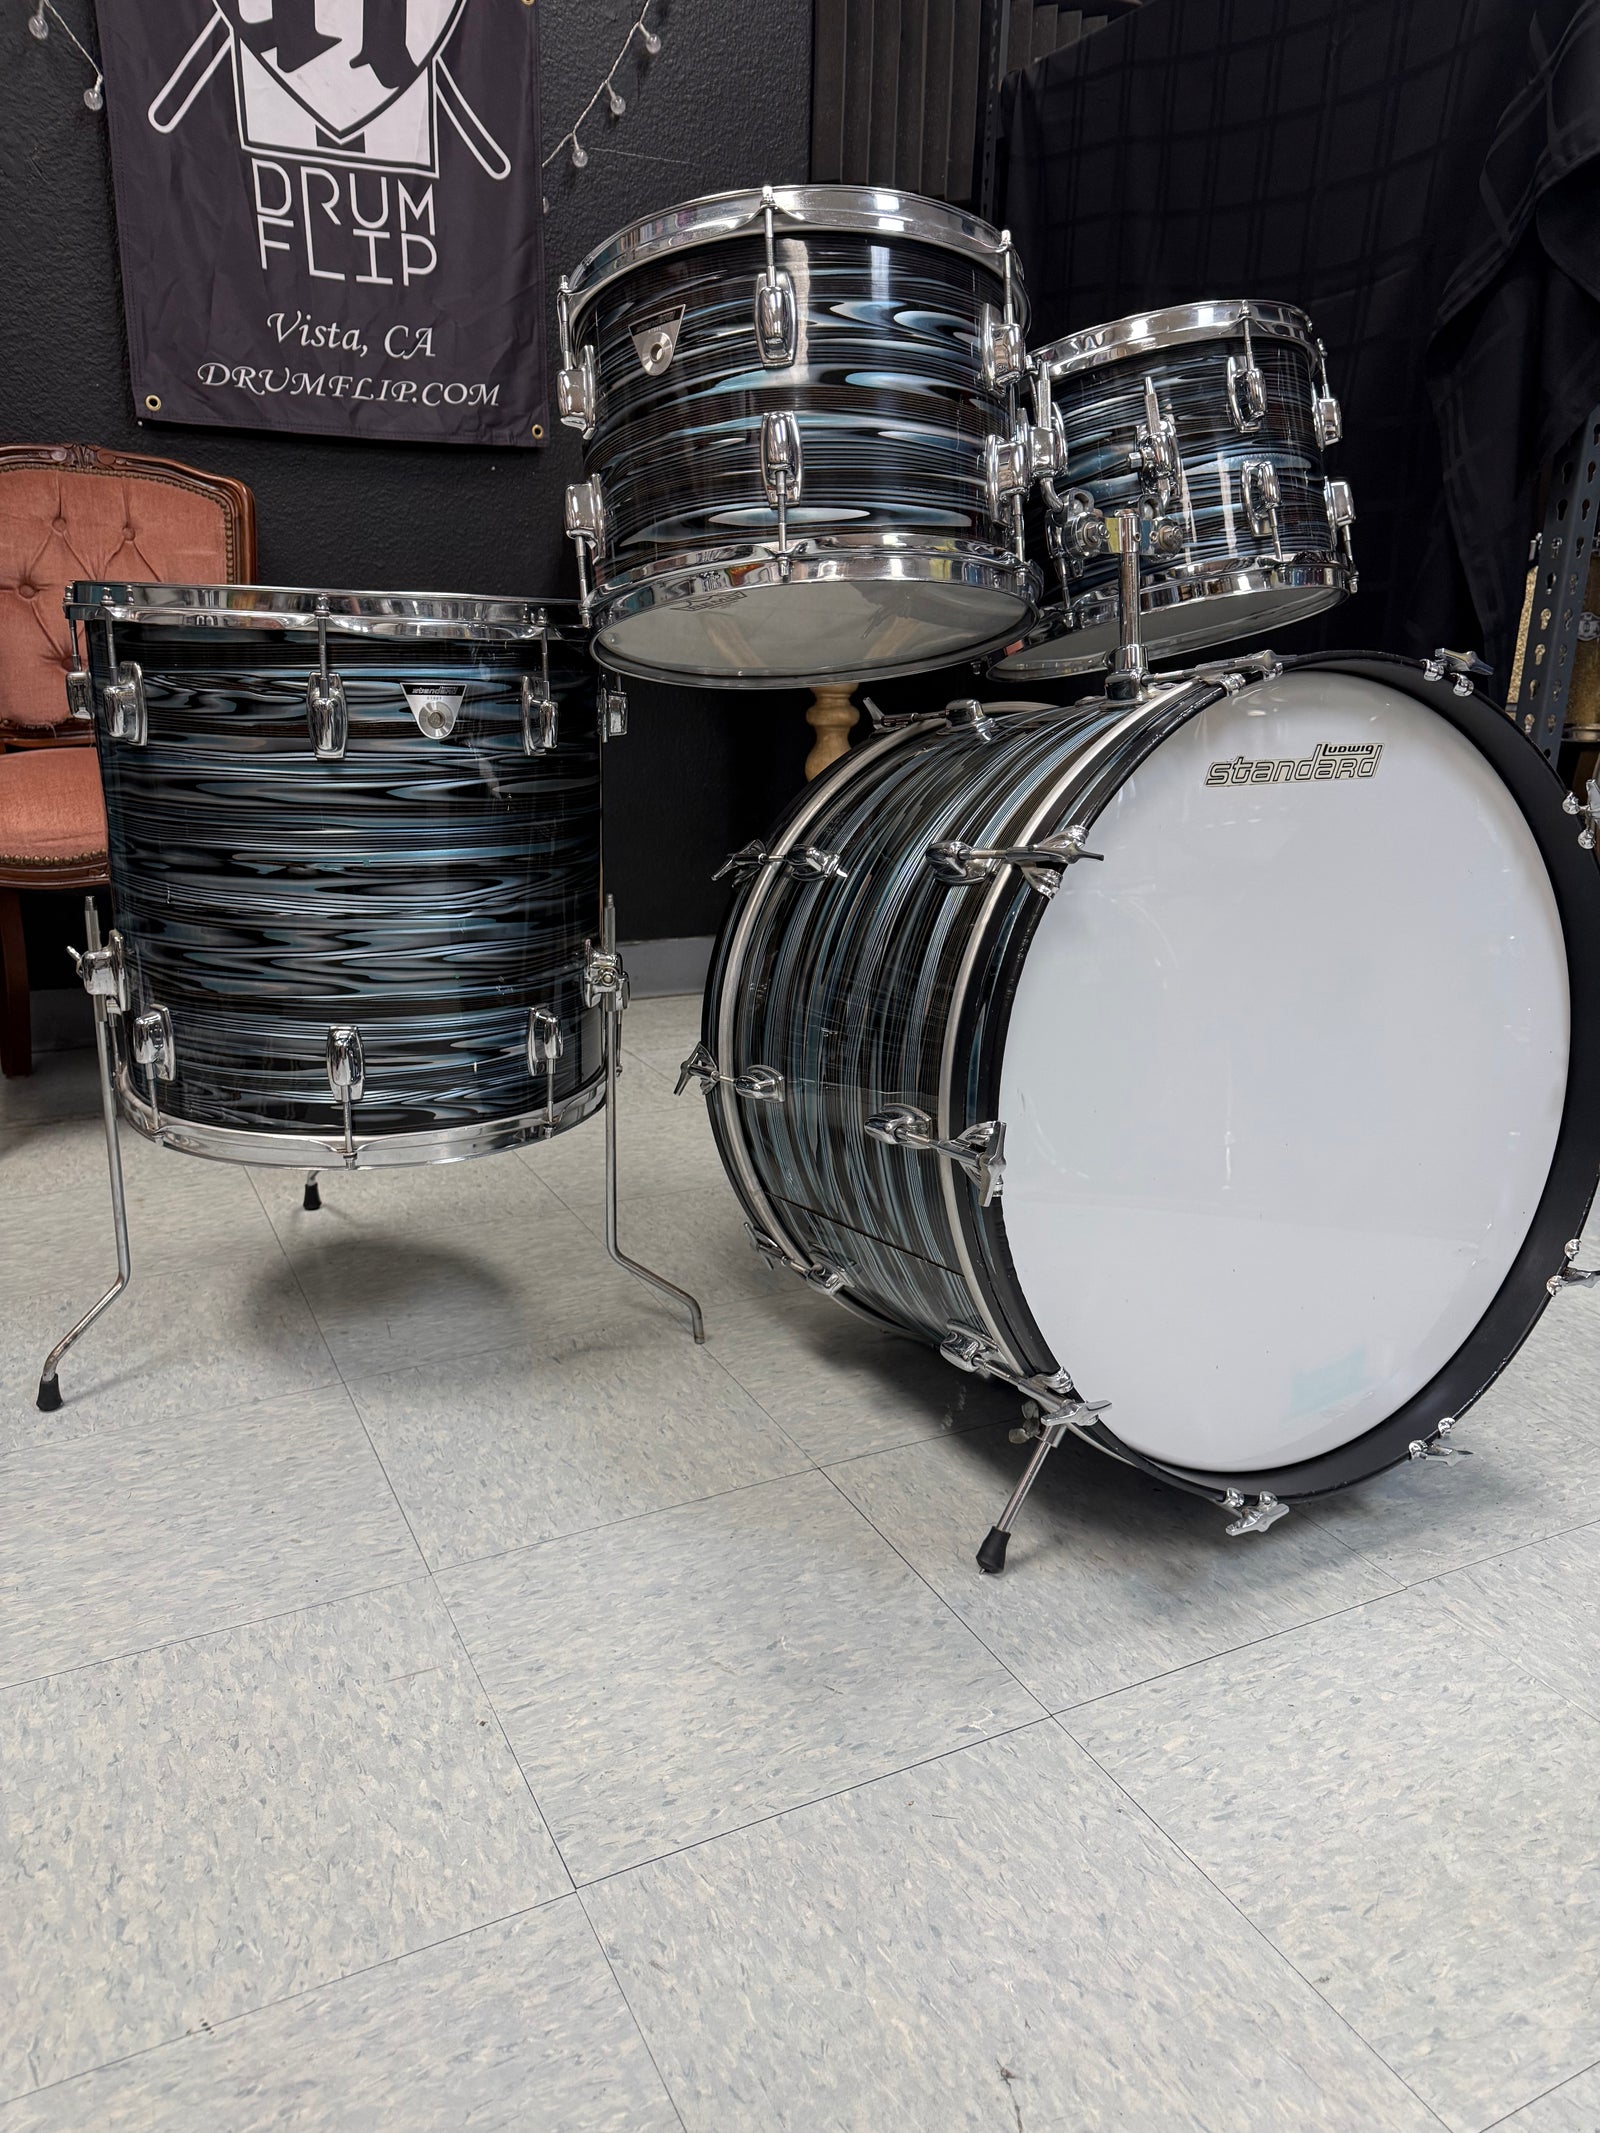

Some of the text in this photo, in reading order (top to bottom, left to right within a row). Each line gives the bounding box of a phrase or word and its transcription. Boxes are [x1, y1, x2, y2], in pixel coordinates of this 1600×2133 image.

[251, 157, 436, 237] DRUM
[257, 214, 438, 287] FLIP
[266, 310, 436, 360] Vista, CA
[196, 362, 500, 408] DRUMFLIP.COM
